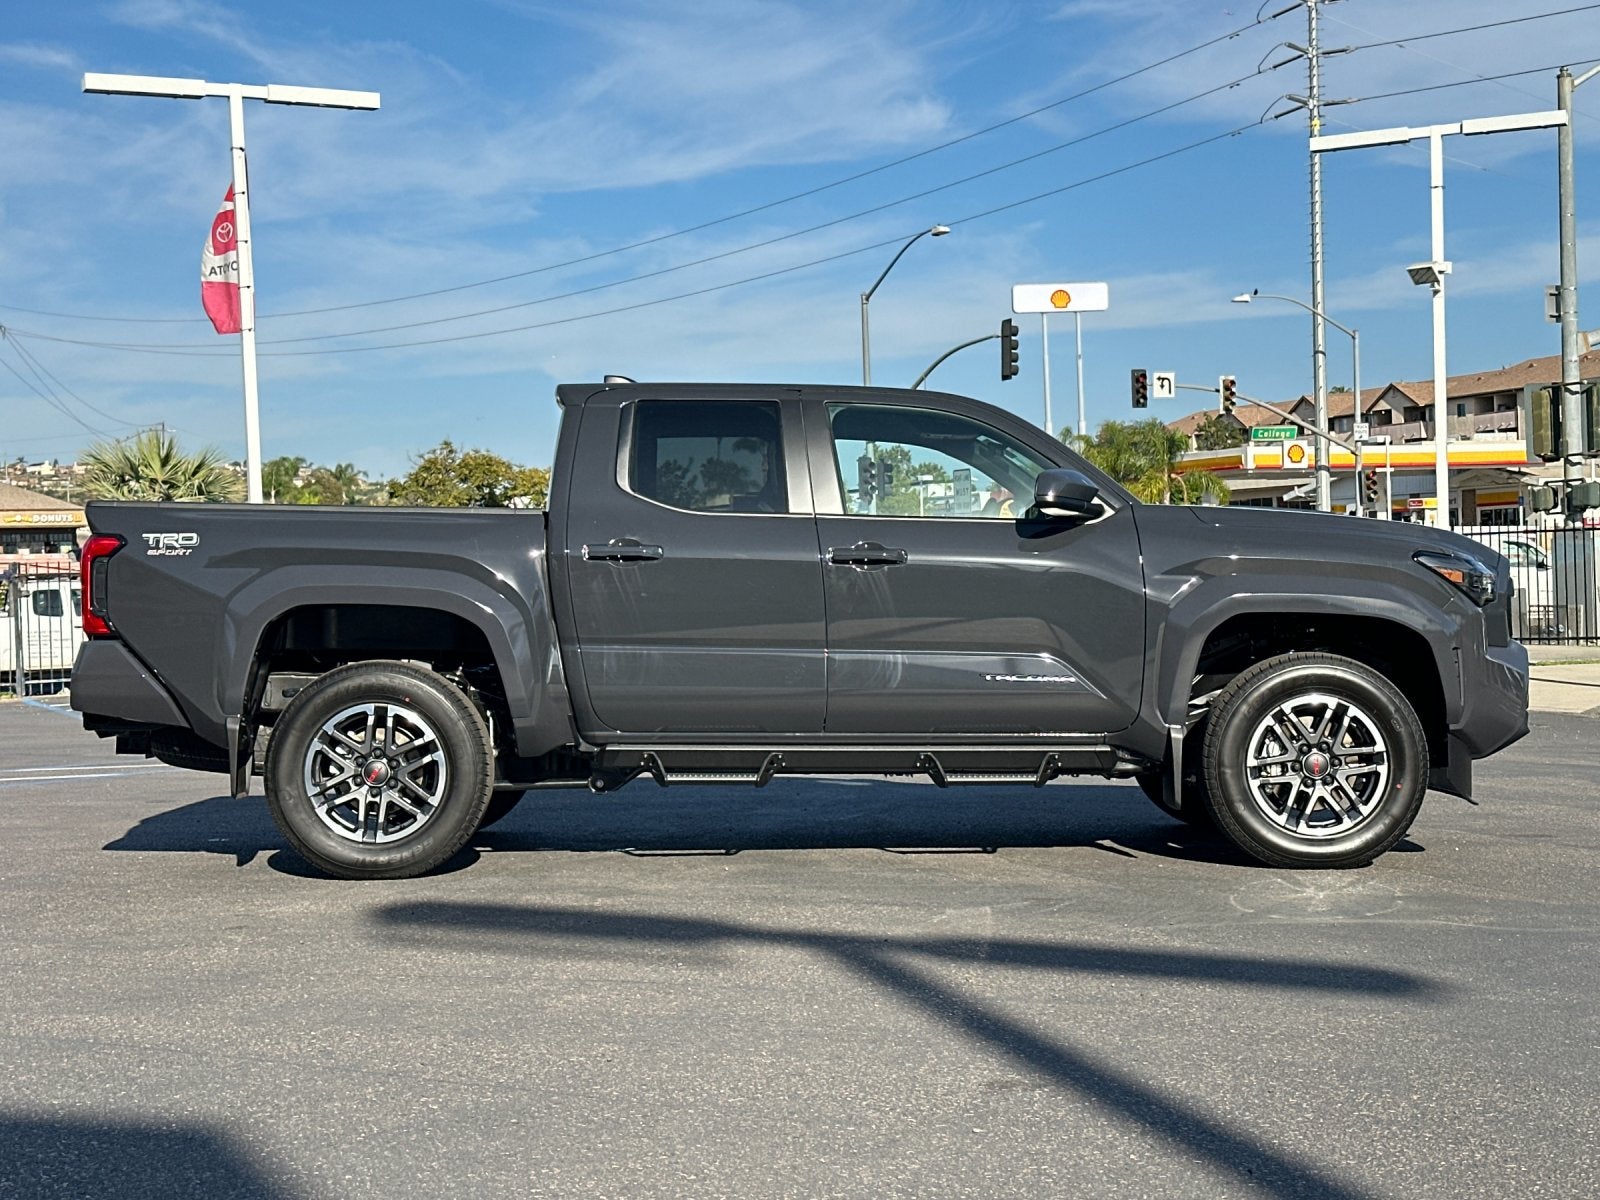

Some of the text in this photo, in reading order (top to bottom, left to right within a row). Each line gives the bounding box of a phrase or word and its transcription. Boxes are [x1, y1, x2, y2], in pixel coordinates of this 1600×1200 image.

[1258, 429, 1291, 439] College
[32, 513, 73, 523] DONUTS
[142, 533, 200, 548] TRD
[147, 548, 193, 556] SPORT
